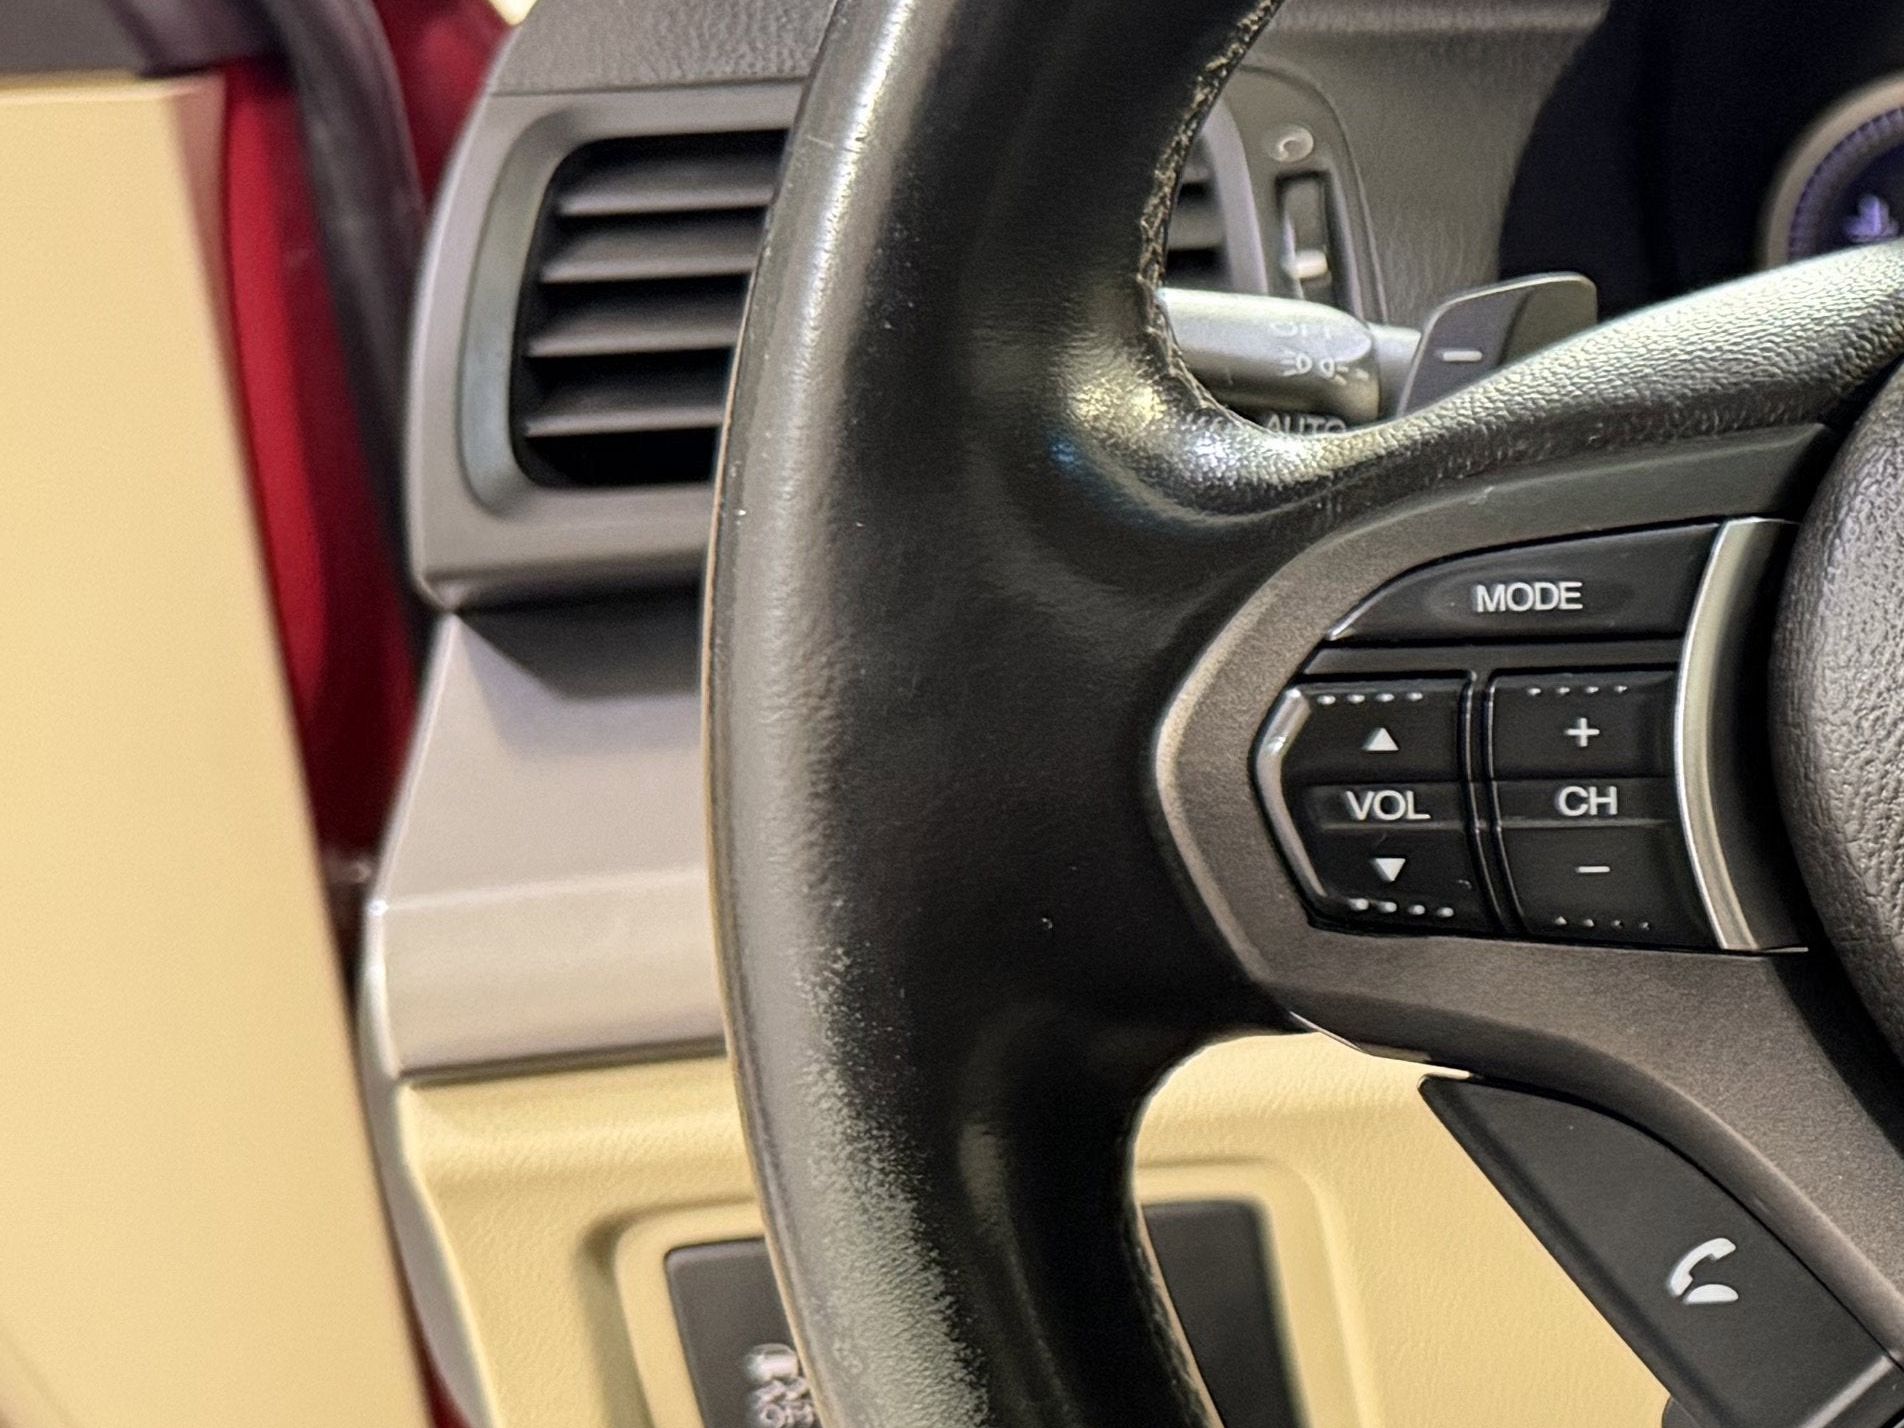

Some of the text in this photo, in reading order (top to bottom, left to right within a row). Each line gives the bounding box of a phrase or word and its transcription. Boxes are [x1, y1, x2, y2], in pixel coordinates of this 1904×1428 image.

[1475, 581, 1584, 613] MODE
[1346, 791, 1432, 821] VOL
[1557, 785, 1619, 816] CH
